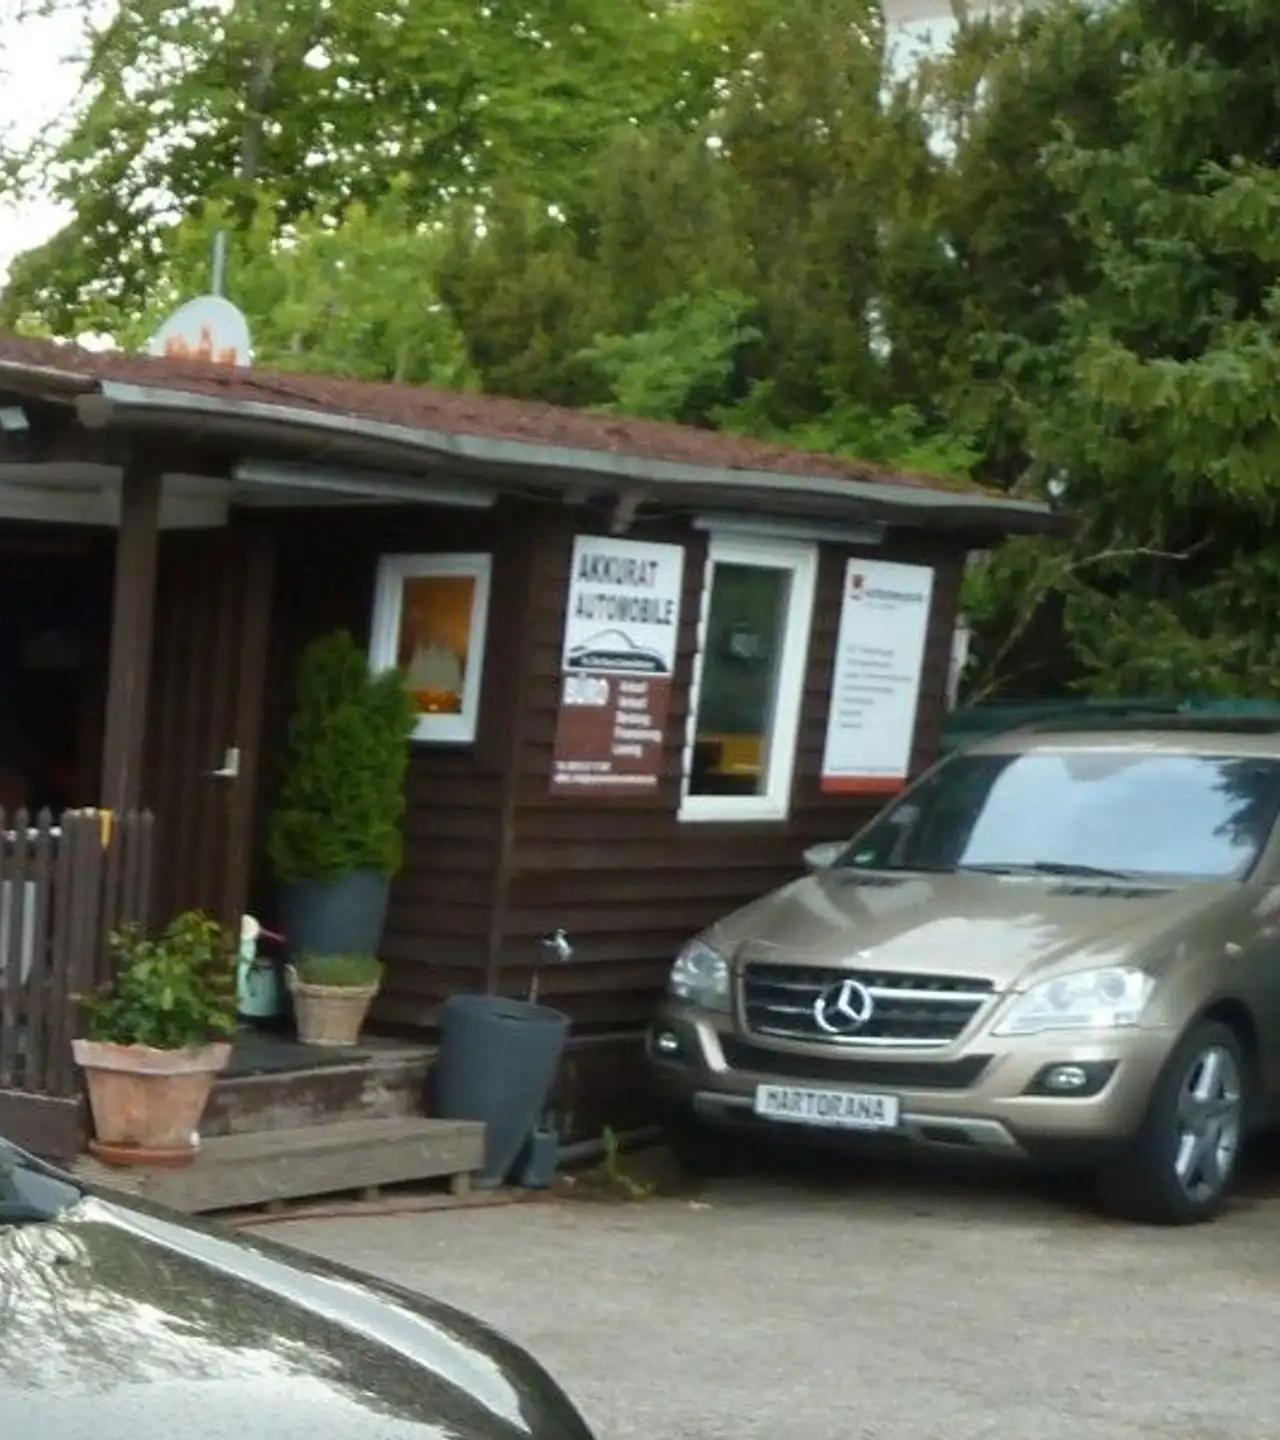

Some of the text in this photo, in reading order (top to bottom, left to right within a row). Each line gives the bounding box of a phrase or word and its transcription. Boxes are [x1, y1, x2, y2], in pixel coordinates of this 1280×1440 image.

[579, 553, 658, 588] AKKURAT
[575, 592, 674, 625] AUTOMOBILE
[766, 1089, 886, 1121] MARTORANA
